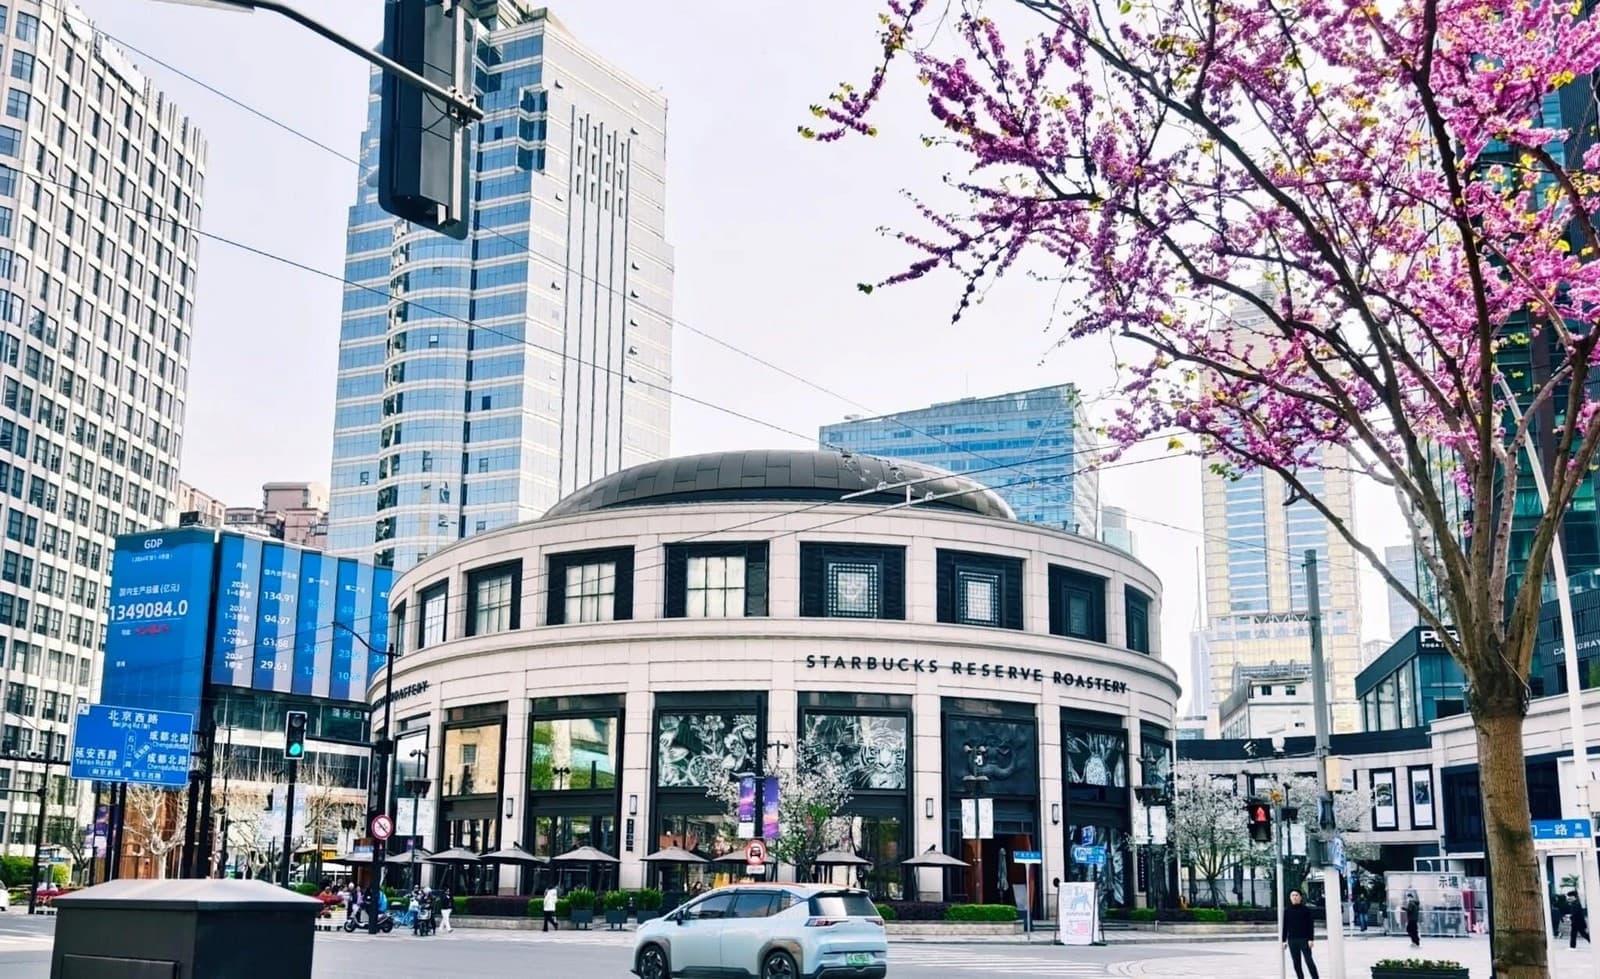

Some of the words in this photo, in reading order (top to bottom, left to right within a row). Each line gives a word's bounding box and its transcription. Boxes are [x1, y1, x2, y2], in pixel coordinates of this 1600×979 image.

[144, 538, 163, 549] GDP
[263, 591, 294, 603] 134.91
[109, 599, 188, 621] 1349084.0
[806, 655, 938, 673] STARBUCKS
[952, 661, 1042, 682] RESERVE
[1053, 670, 1128, 694] ROASTERY
[108, 709, 159, 724] 北京西路
[149, 731, 189, 743] 成都北路
[75, 748, 117, 760] 延安西路
[147, 753, 187, 766] 成都北路
